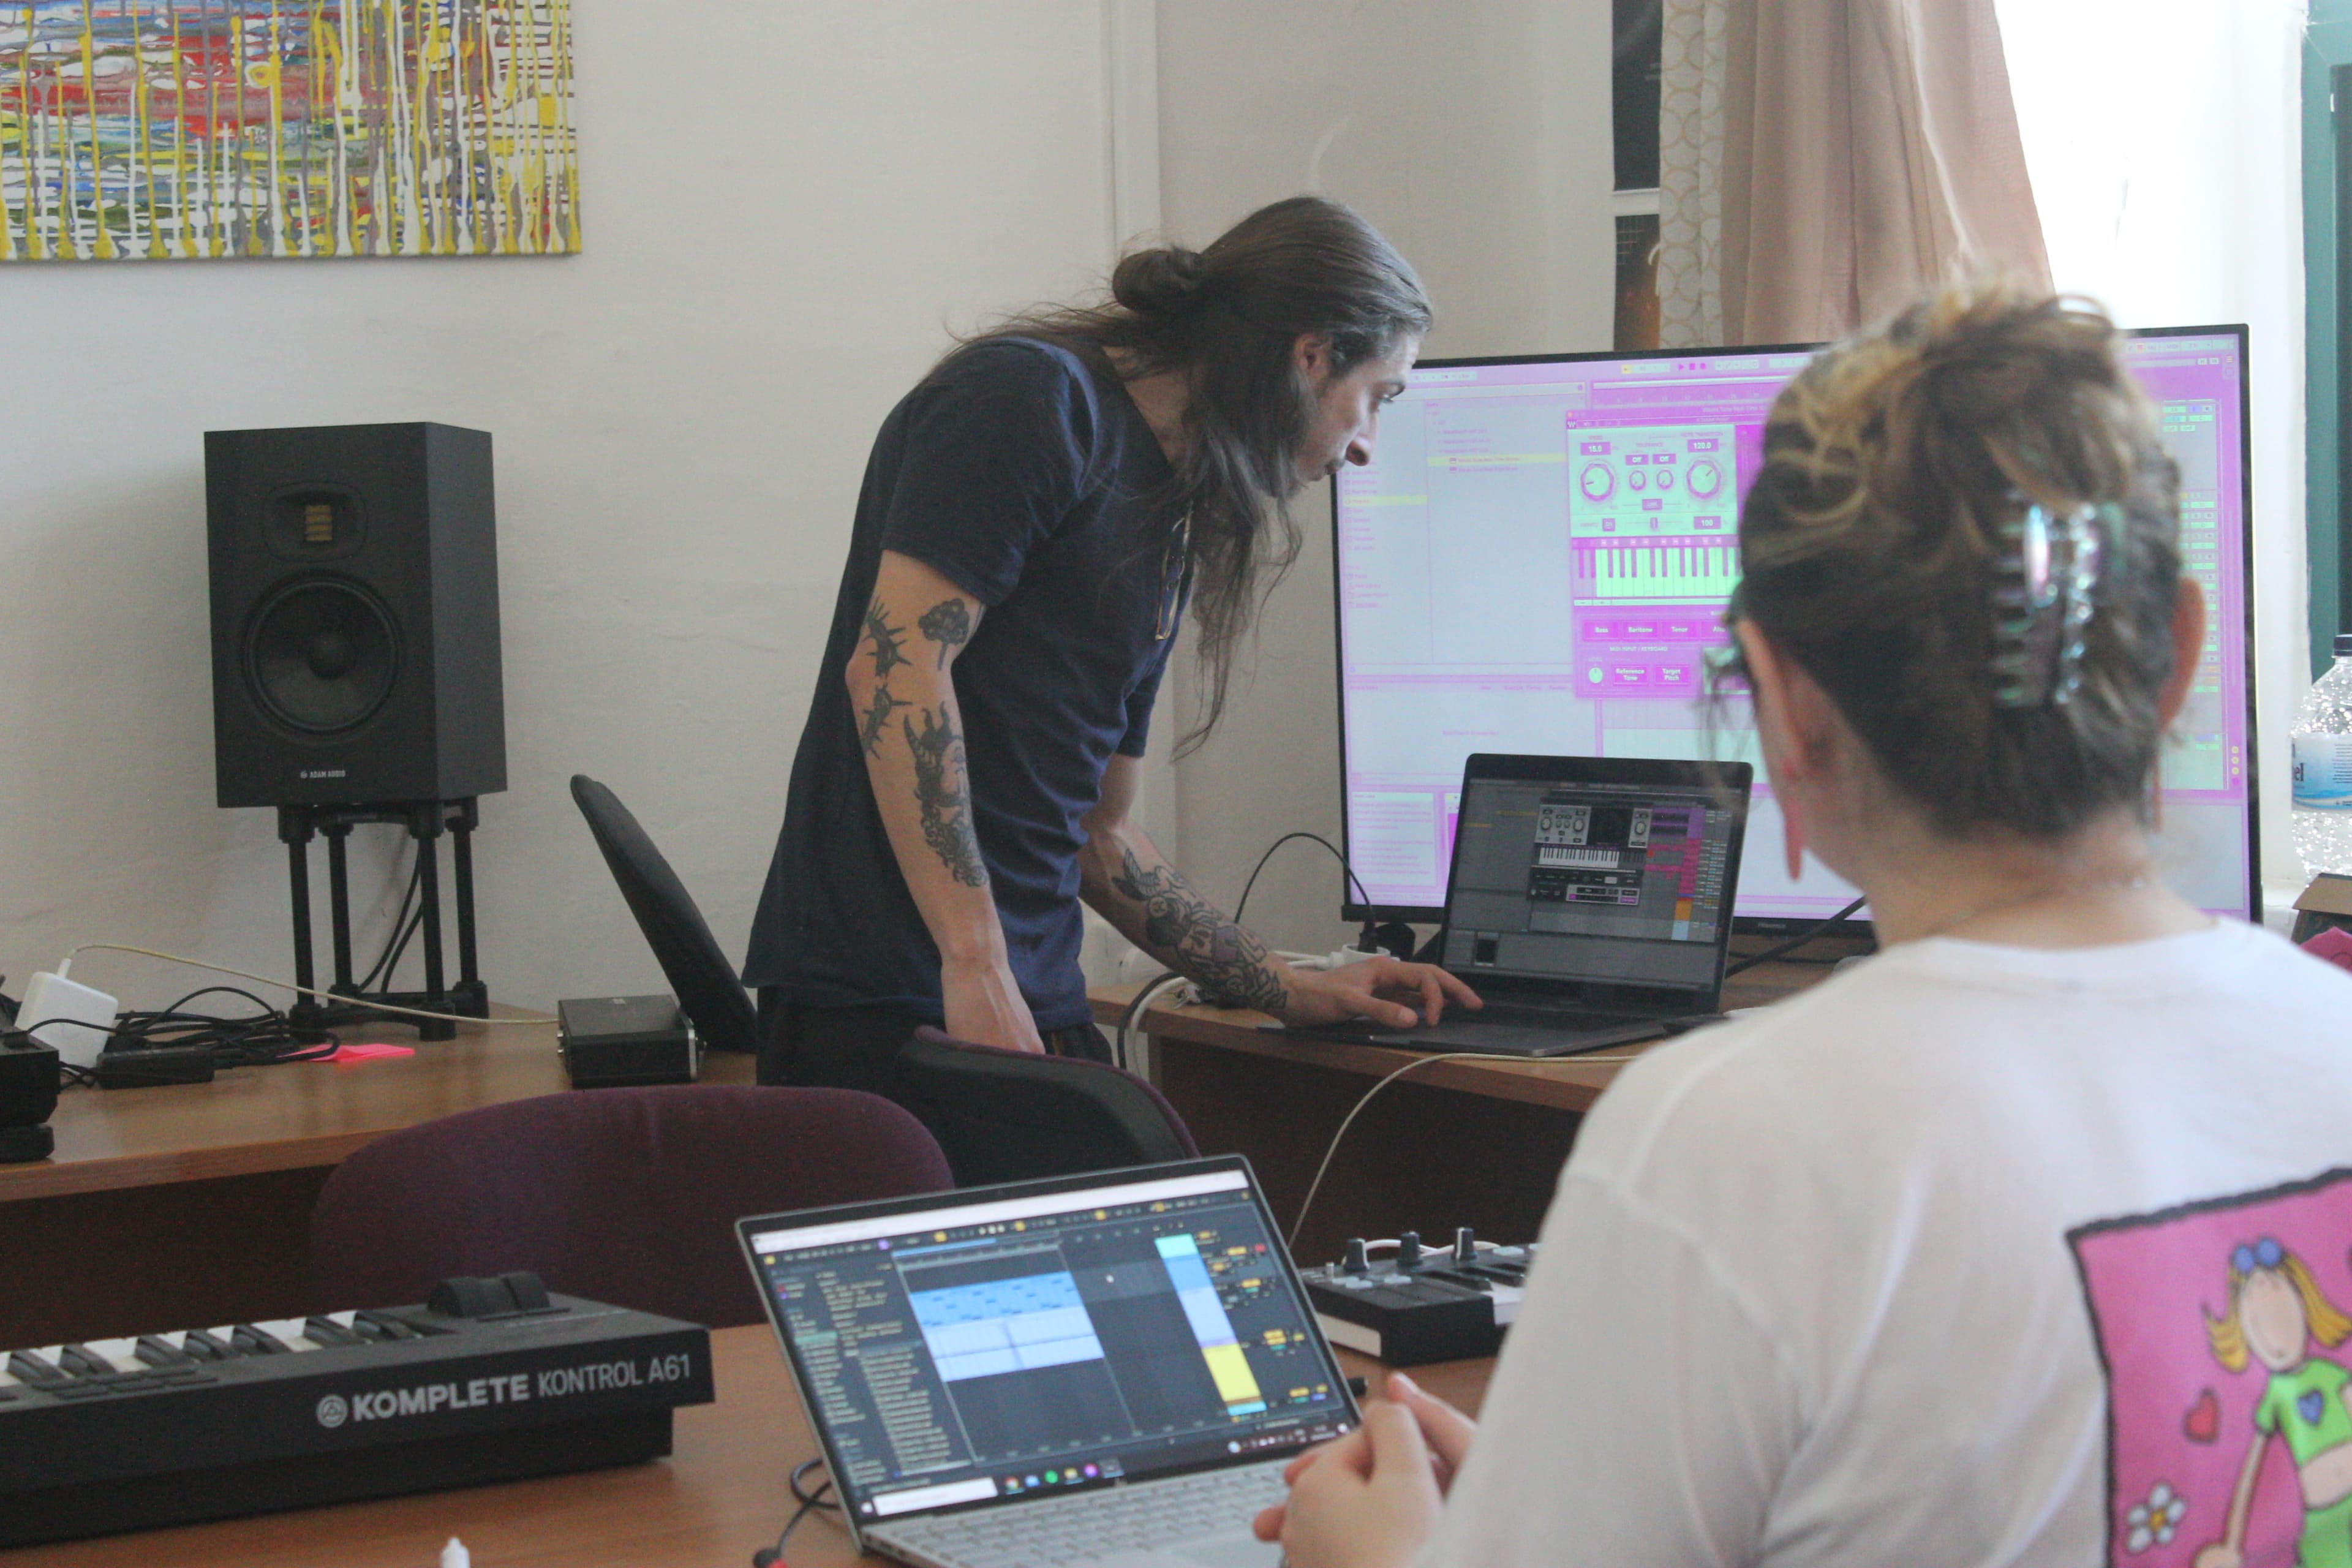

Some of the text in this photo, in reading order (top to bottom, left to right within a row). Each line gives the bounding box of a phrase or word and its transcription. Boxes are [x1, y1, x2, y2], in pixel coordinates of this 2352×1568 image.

[352, 1353, 692, 1422] KOMPLETE KONTROL A61
